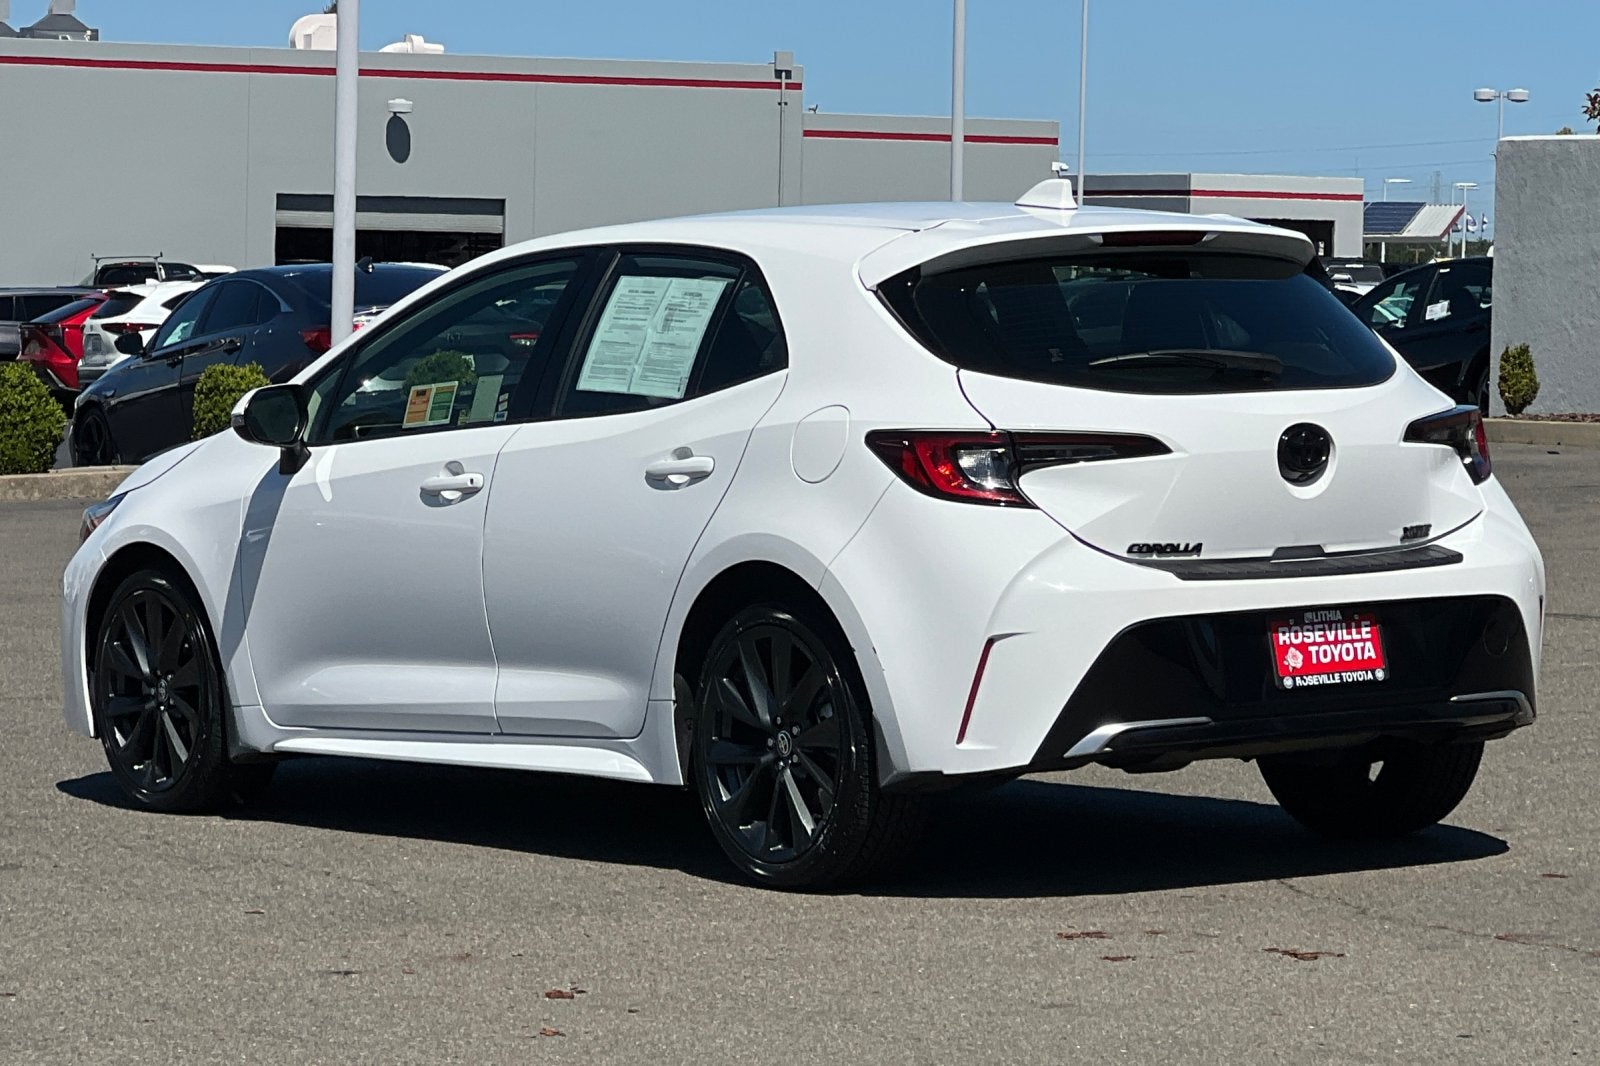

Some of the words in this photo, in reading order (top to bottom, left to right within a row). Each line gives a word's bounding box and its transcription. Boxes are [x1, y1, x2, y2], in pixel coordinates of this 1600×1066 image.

[1126, 542, 1203, 556] COROLLA
[1313, 610, 1343, 622] LITHIA
[1278, 621, 1372, 645] ROSEVILLE
[1308, 641, 1376, 664] TOYOTA
[1295, 673, 1341, 687] ROSEVILLE
[1342, 670, 1374, 683] TOYOTA
